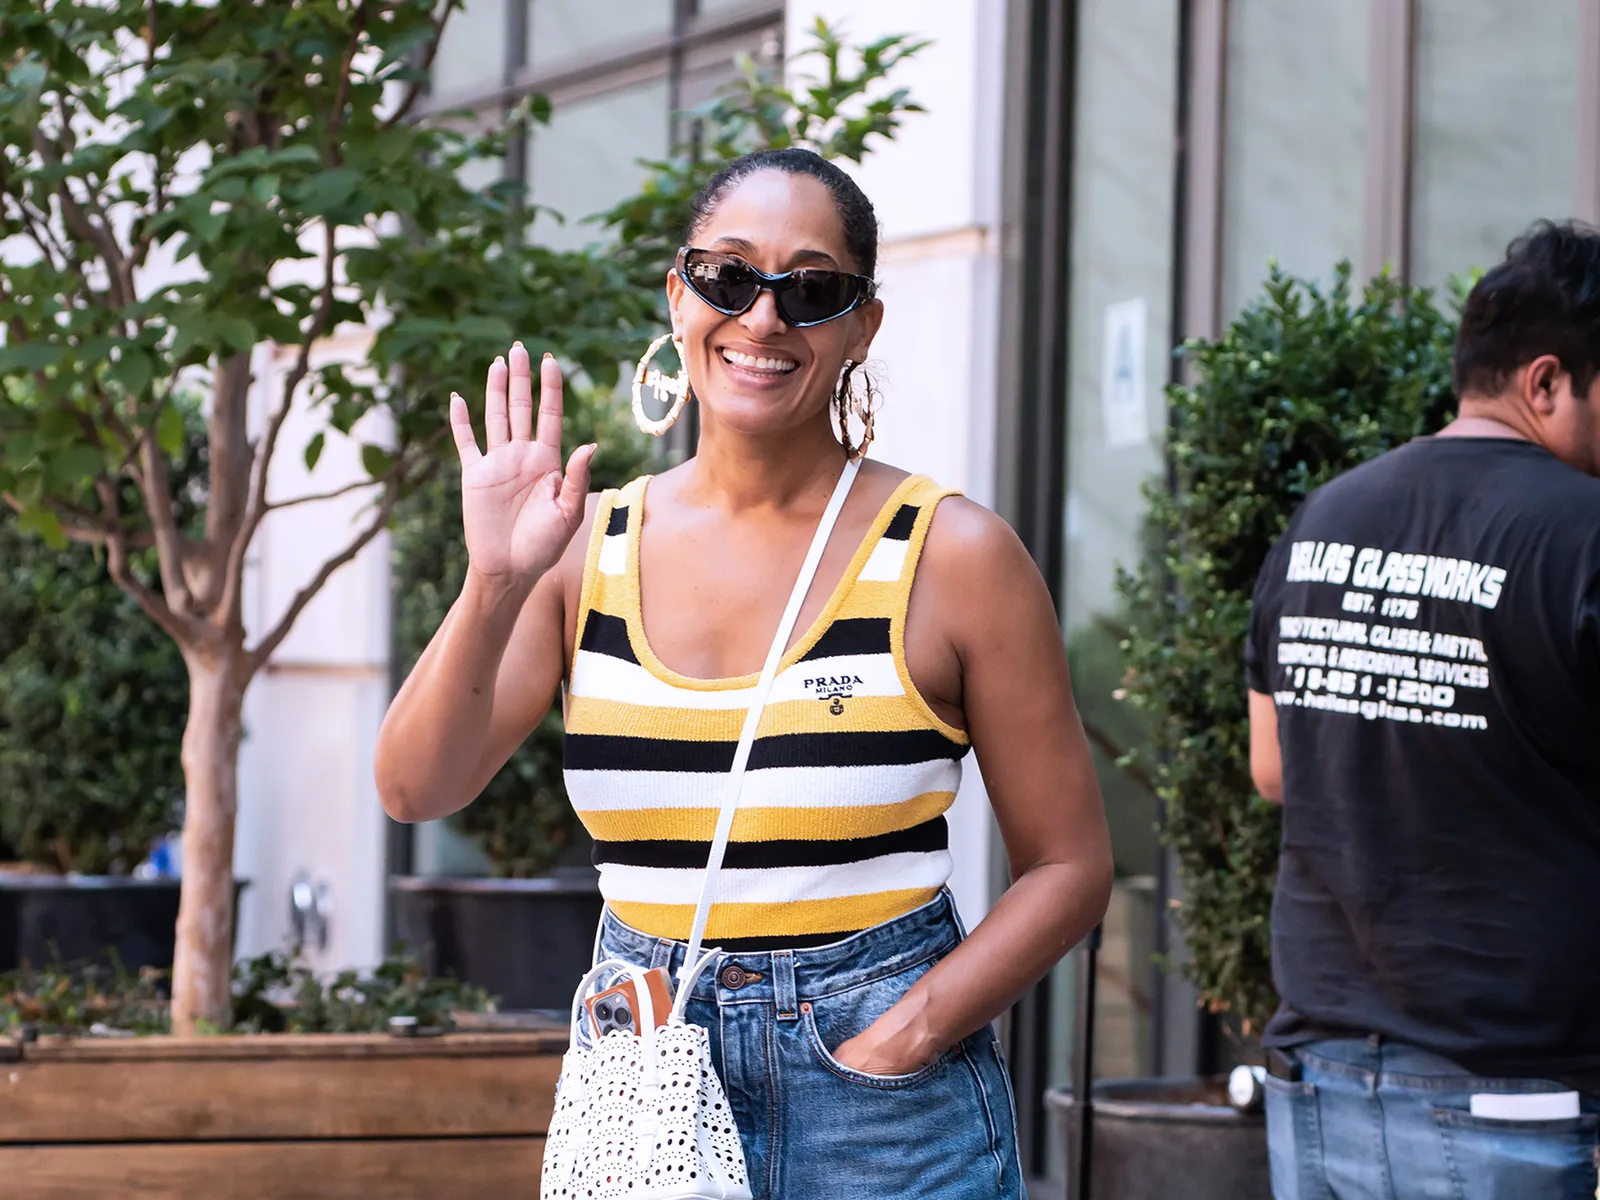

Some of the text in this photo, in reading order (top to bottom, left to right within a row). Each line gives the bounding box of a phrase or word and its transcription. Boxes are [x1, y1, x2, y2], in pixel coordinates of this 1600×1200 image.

[1352, 547, 1507, 610] GLASSWORKS
[1279, 616, 1368, 645] TECTURAL
[1432, 632, 1488, 662] METAL
[804, 675, 863, 688] PRADA
[816, 685, 853, 693] MILANO
[1418, 658, 1489, 689] SERVICES
